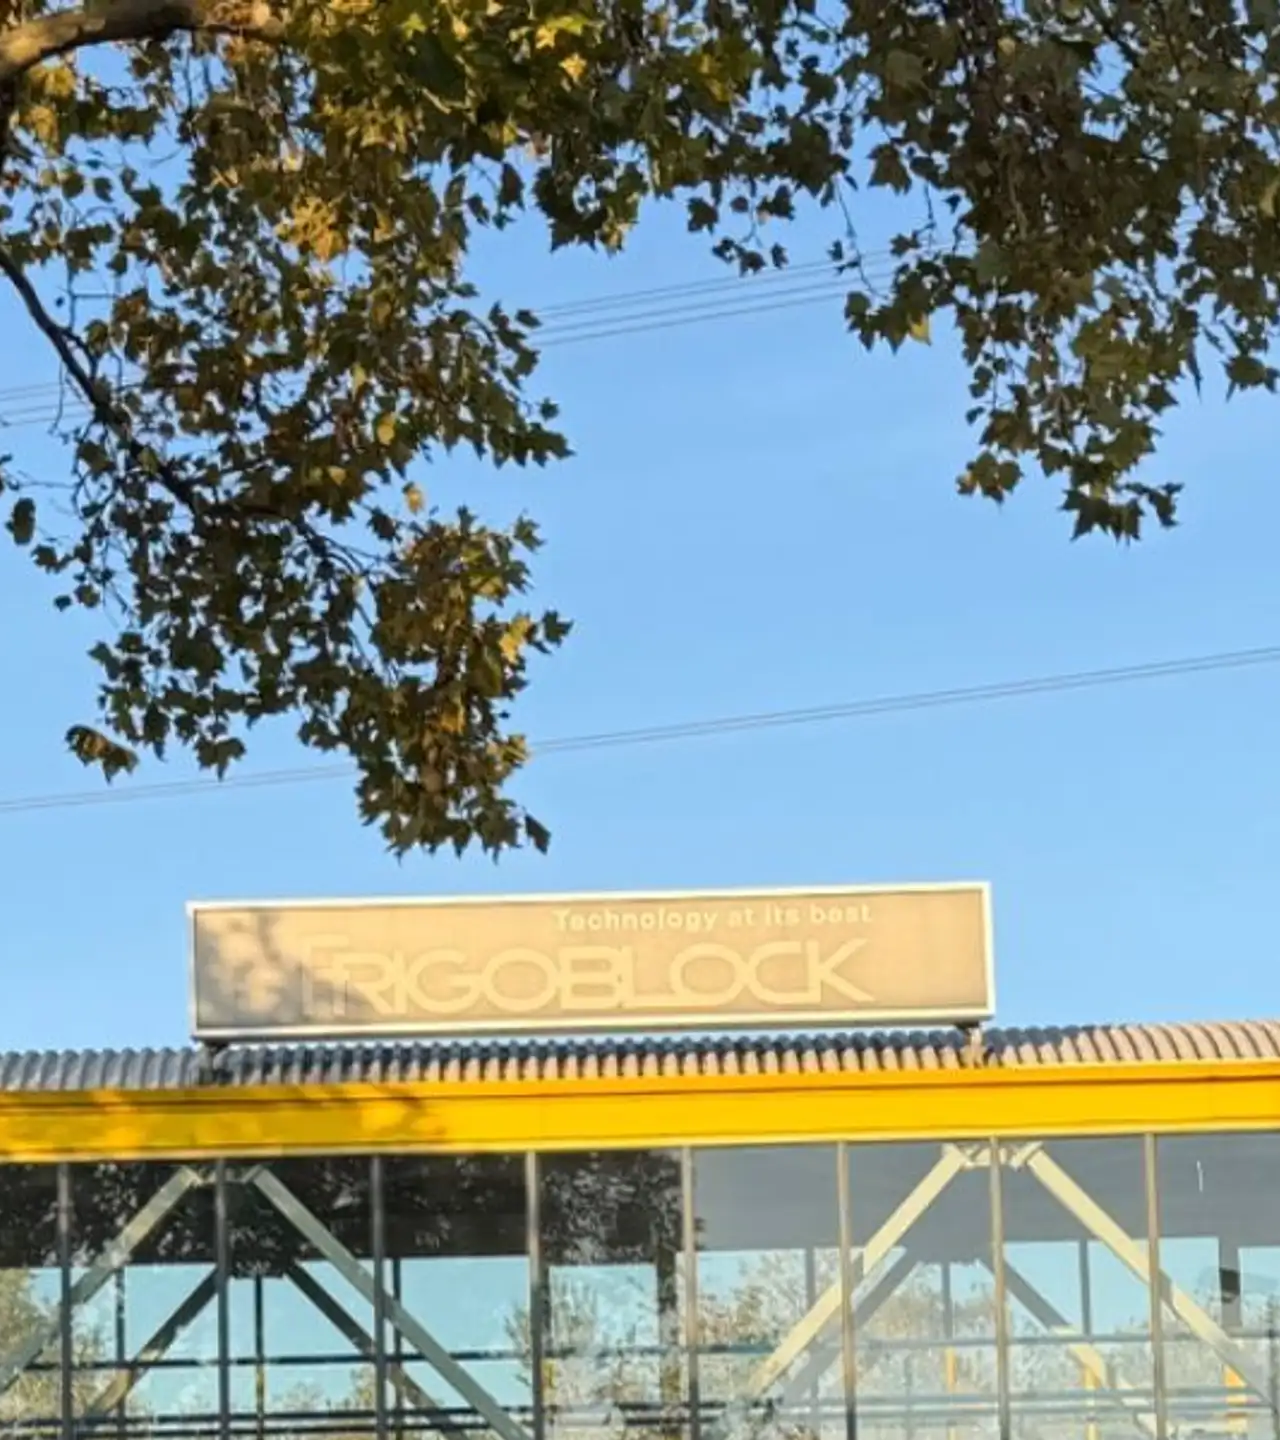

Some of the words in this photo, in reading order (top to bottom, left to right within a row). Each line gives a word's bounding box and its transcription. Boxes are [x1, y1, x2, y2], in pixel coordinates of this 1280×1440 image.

[552, 906, 719, 933] Technology
[727, 907, 755, 928] at
[809, 902, 873, 925] best
[302, 933, 876, 1016] FRIGOBLOCK
